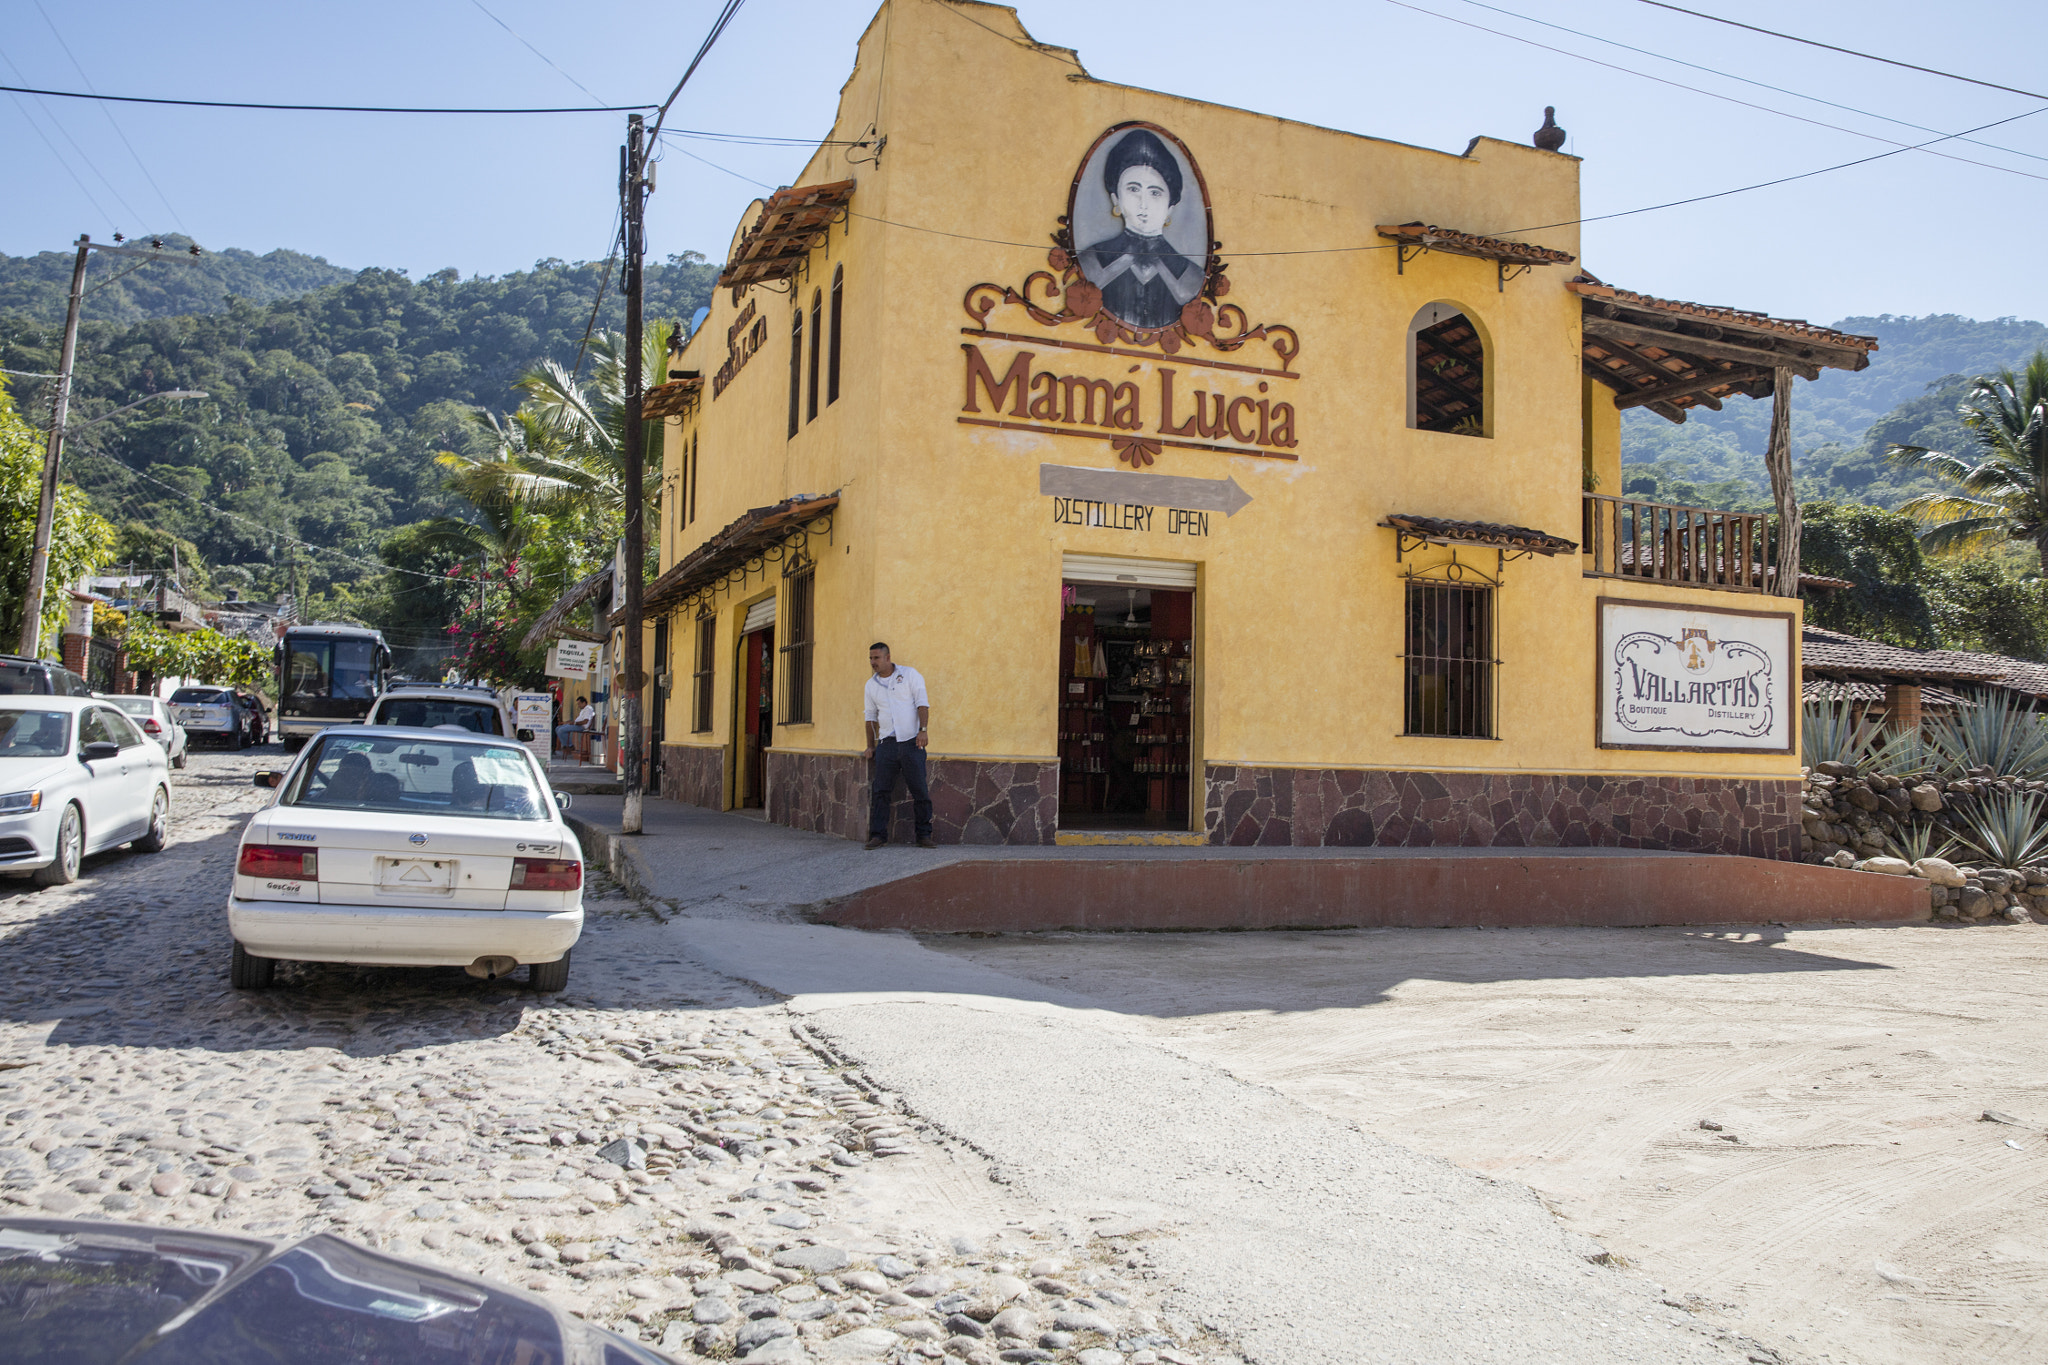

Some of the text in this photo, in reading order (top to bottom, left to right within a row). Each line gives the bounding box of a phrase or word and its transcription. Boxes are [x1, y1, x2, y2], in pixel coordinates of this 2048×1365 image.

[961, 343, 1299, 449] Mamá Lucia
[1054, 497, 1209, 536] DISTILLERY OPEN
[559, 649, 585, 657] TEQUILA
[1627, 657, 1763, 708] VALLARTA'S
[1629, 704, 1755, 720] BOUTIQUE DISTILLERY
[277, 832, 316, 841] TSURU
[267, 882, 302, 891] GasCard
